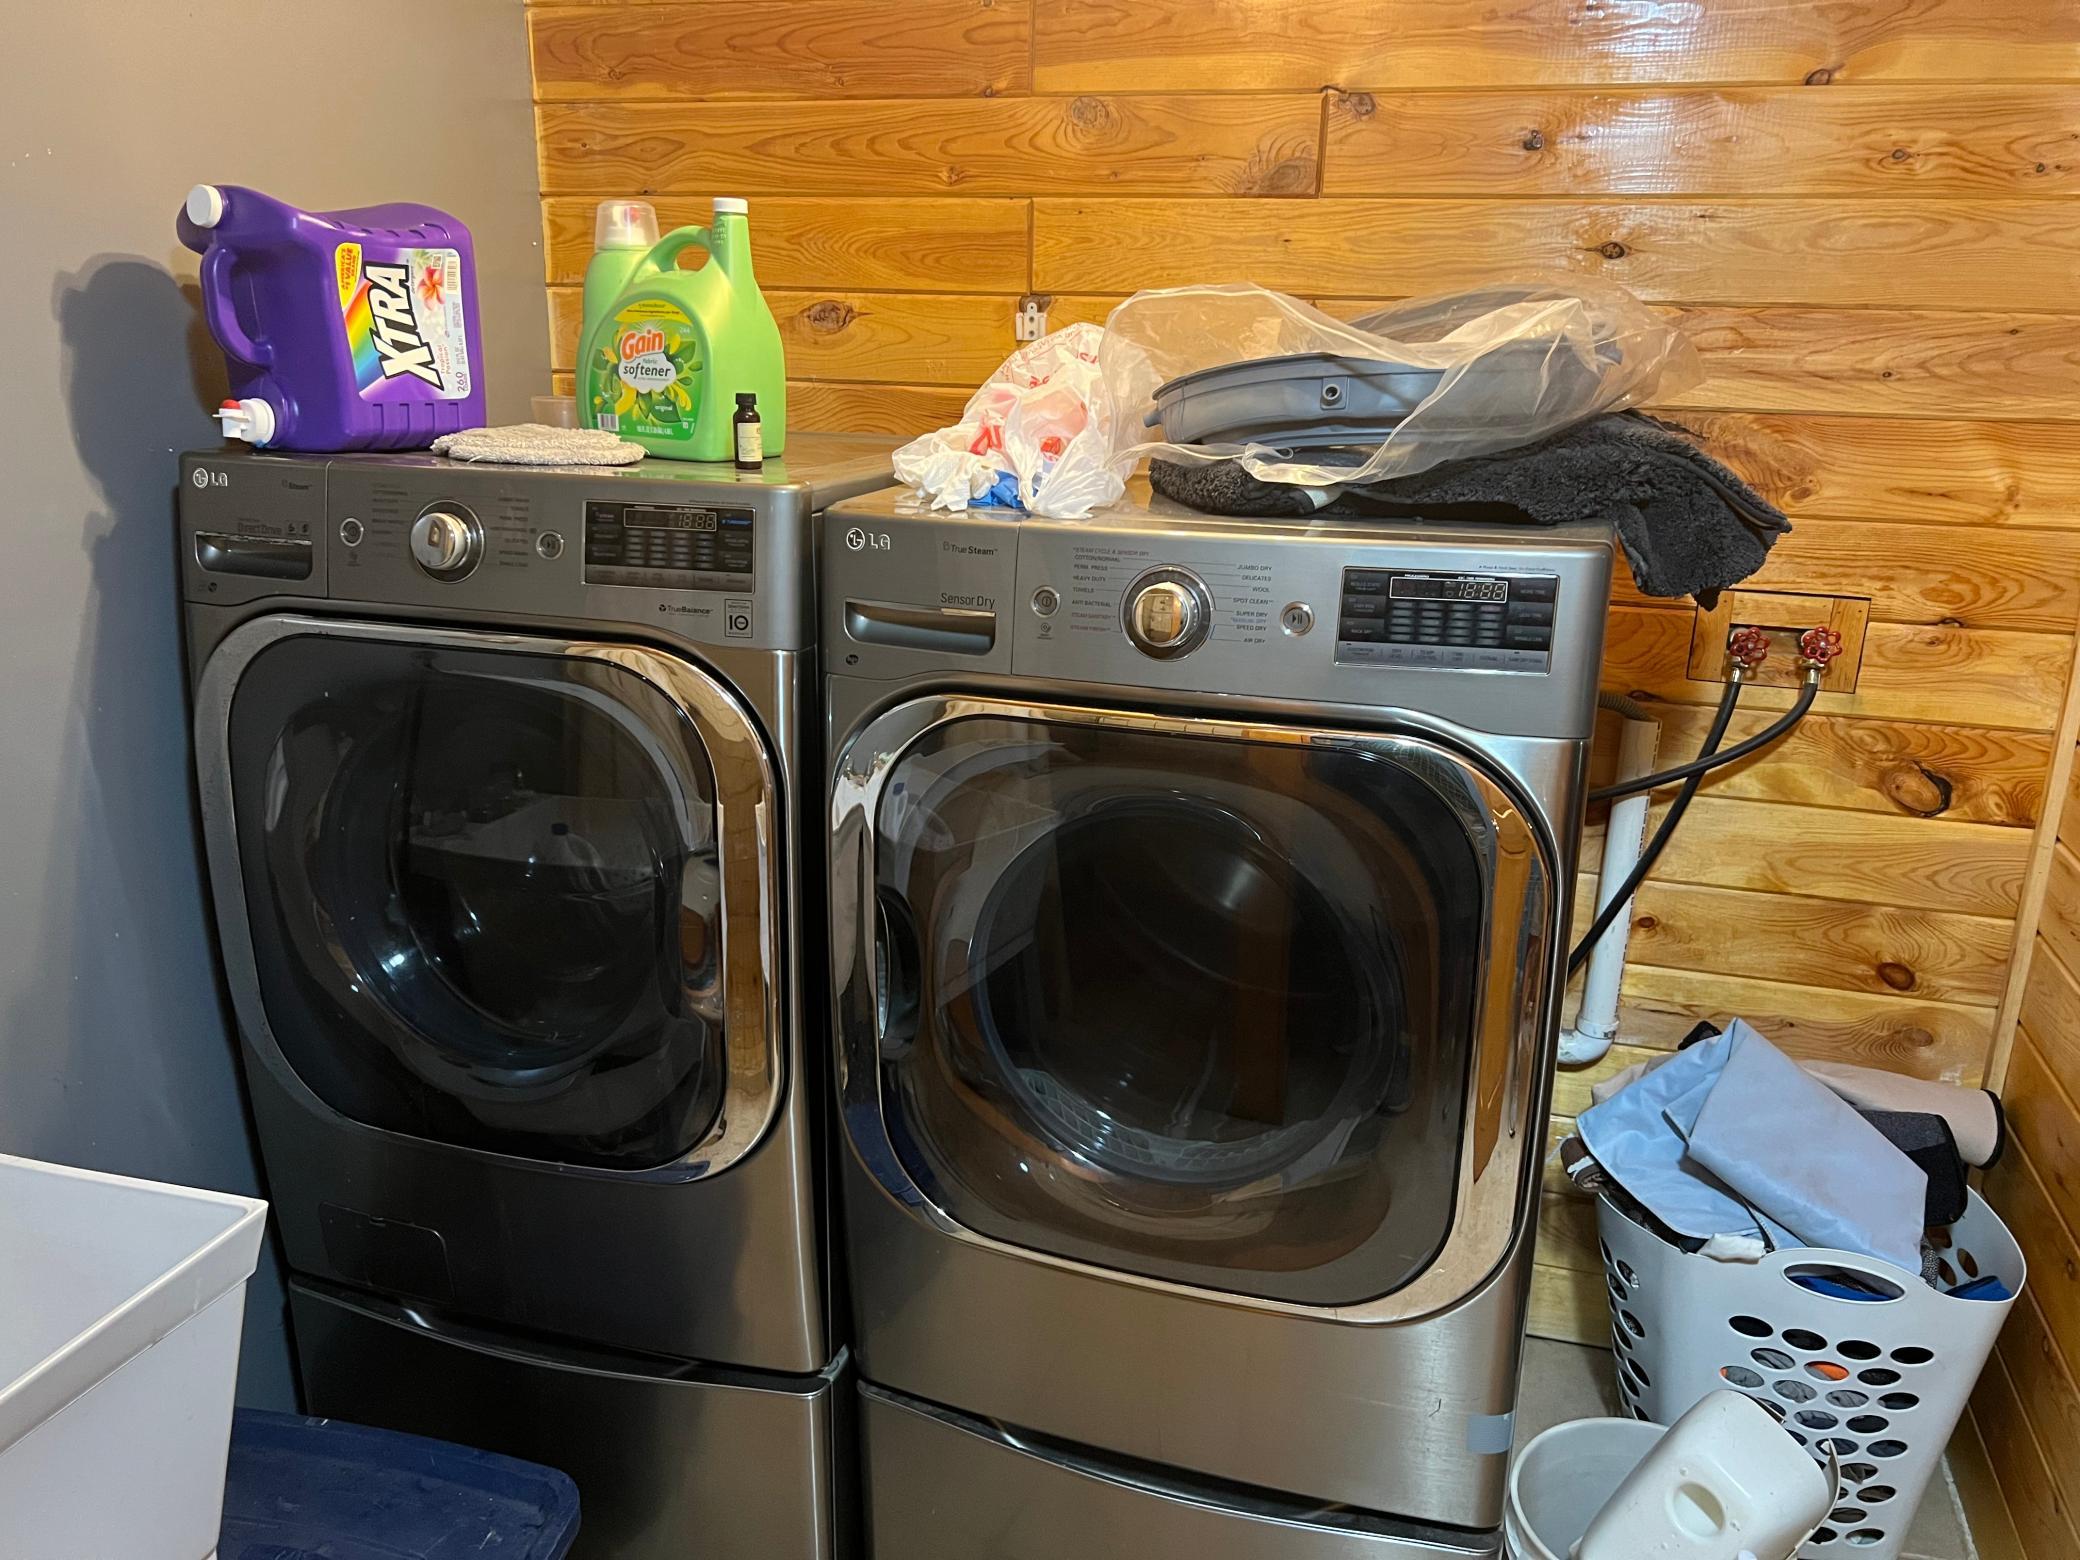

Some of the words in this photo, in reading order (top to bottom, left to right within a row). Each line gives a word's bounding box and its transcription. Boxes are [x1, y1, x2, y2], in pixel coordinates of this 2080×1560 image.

[344, 248, 353, 281] VALUE
[363, 261, 445, 391] XTRA
[621, 328, 664, 361] Gain
[437, 344, 445, 374] Tropical
[623, 363, 671, 379] softener
[455, 372, 464, 392] 260
[869, 533, 891, 550] LG
[940, 592, 975, 606] Sensor
[976, 595, 996, 610] Dry
